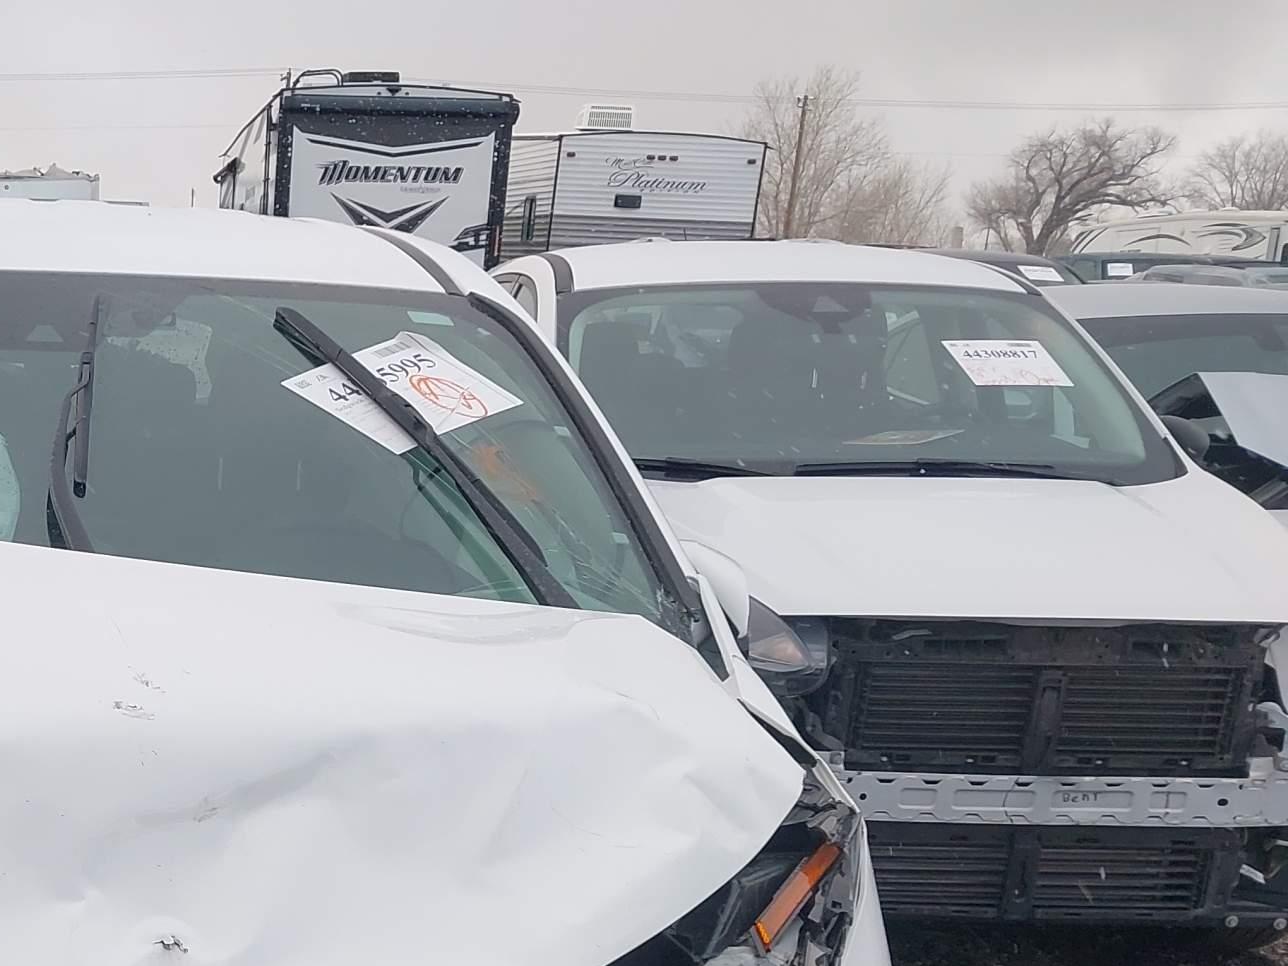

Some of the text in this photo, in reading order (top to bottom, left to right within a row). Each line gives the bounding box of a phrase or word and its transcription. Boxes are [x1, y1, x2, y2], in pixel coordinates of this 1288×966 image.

[316, 159, 464, 186] MOMENTUM
[608, 169, 707, 192] Platinum
[962, 349, 1038, 359] 44308817
[328, 353, 437, 402] 445995
